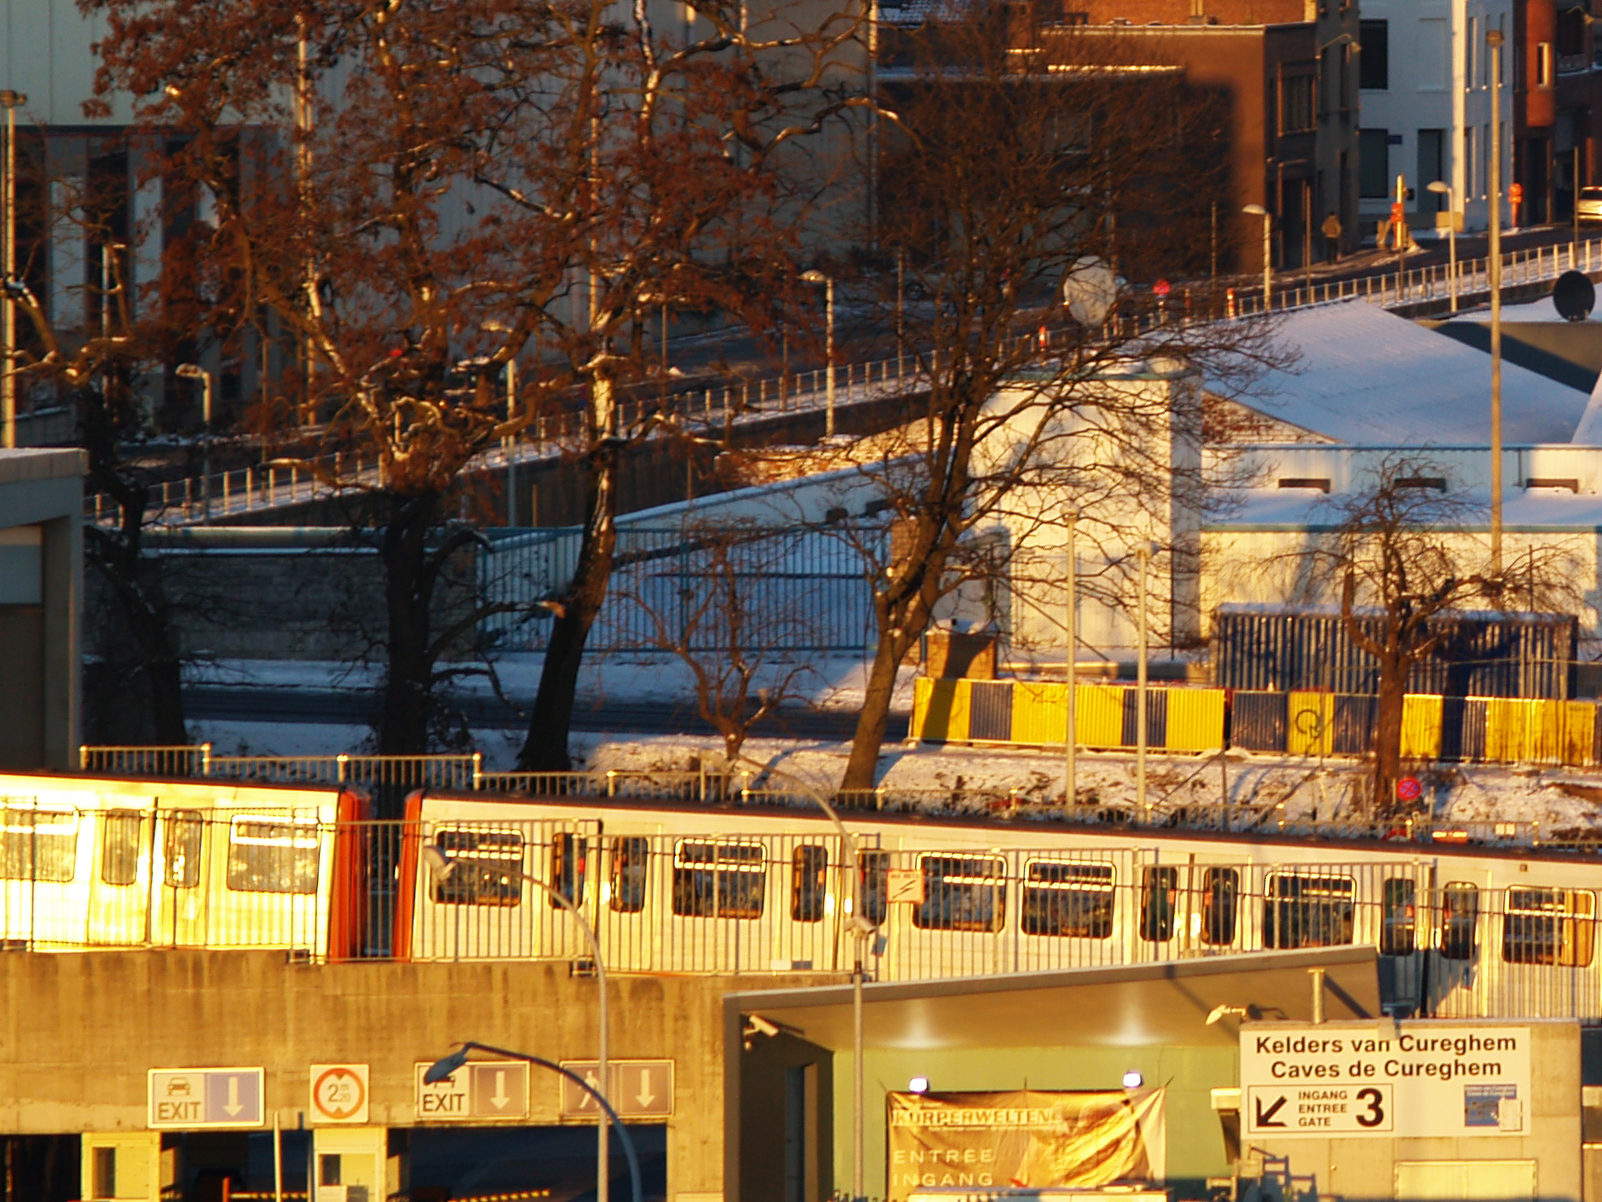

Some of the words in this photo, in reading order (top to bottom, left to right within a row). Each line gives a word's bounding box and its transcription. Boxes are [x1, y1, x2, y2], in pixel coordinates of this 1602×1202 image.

[1256, 1037, 1343, 1054] Kelders
[1351, 1038, 1390, 1053] van
[1399, 1034, 1517, 1056] Cureghem
[1271, 1061, 1340, 1078] Caves
[1348, 1060, 1376, 1077] de
[1384, 1058, 1501, 1080] Cureghem
[328, 1083, 338, 1102] 2
[1298, 1090, 1348, 1100] INGANG
[158, 1102, 201, 1120] EXIT
[423, 1093, 465, 1112] EXIT
[1298, 1103, 1348, 1114] ENTREE
[1356, 1087, 1384, 1127] 3
[1298, 1117, 1331, 1127] GATE
[893, 1149, 993, 1164] ENTREE
[893, 1172, 993, 1187] INGANG
